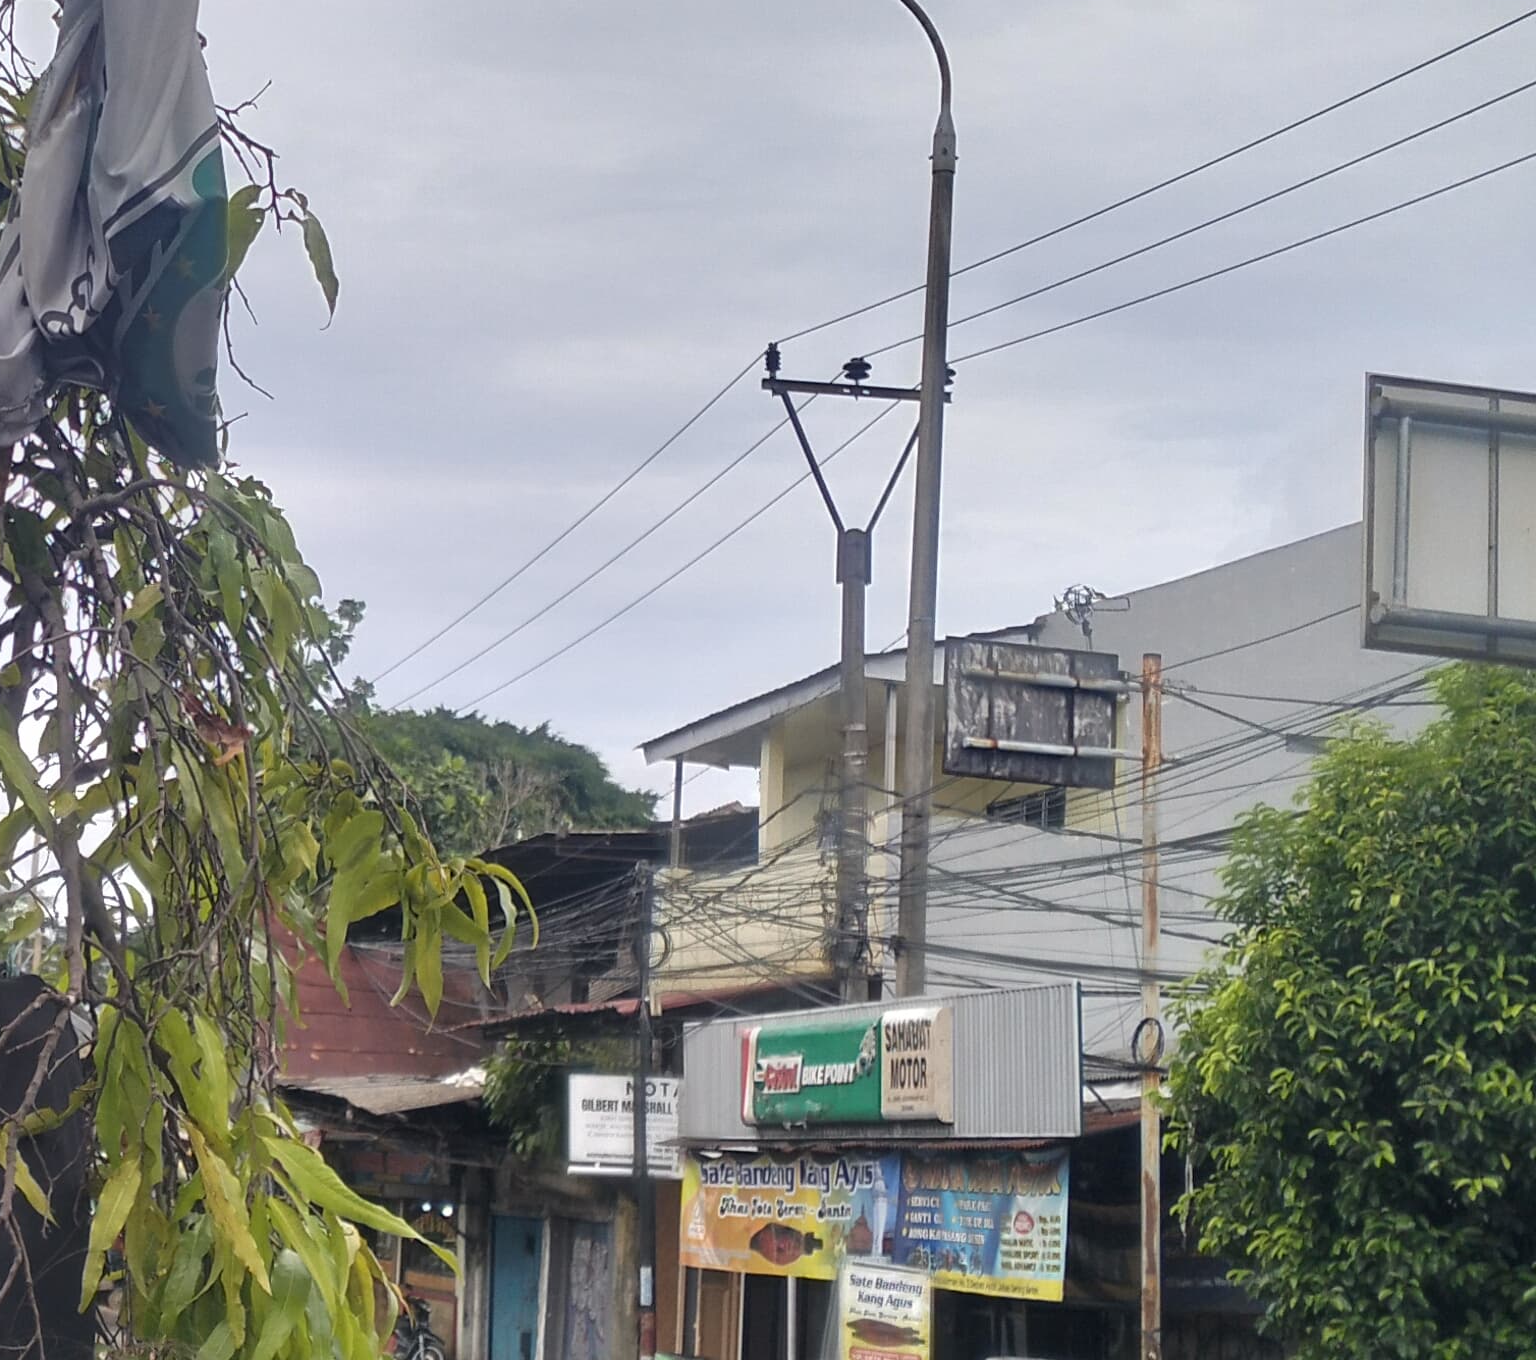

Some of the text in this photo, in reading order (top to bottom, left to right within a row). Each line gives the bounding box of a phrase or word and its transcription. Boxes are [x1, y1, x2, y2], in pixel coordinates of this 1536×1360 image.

[885, 1019, 931, 1052] SAHABAT
[824, 1062, 855, 1084] POINT
[890, 1057, 927, 1089] MOTOR
[581, 1098, 619, 1113] GILBERT
[850, 1274, 873, 1289] Sate
[875, 1277, 923, 1297] Bandeng
[857, 1291, 913, 1310] Kang Agus
